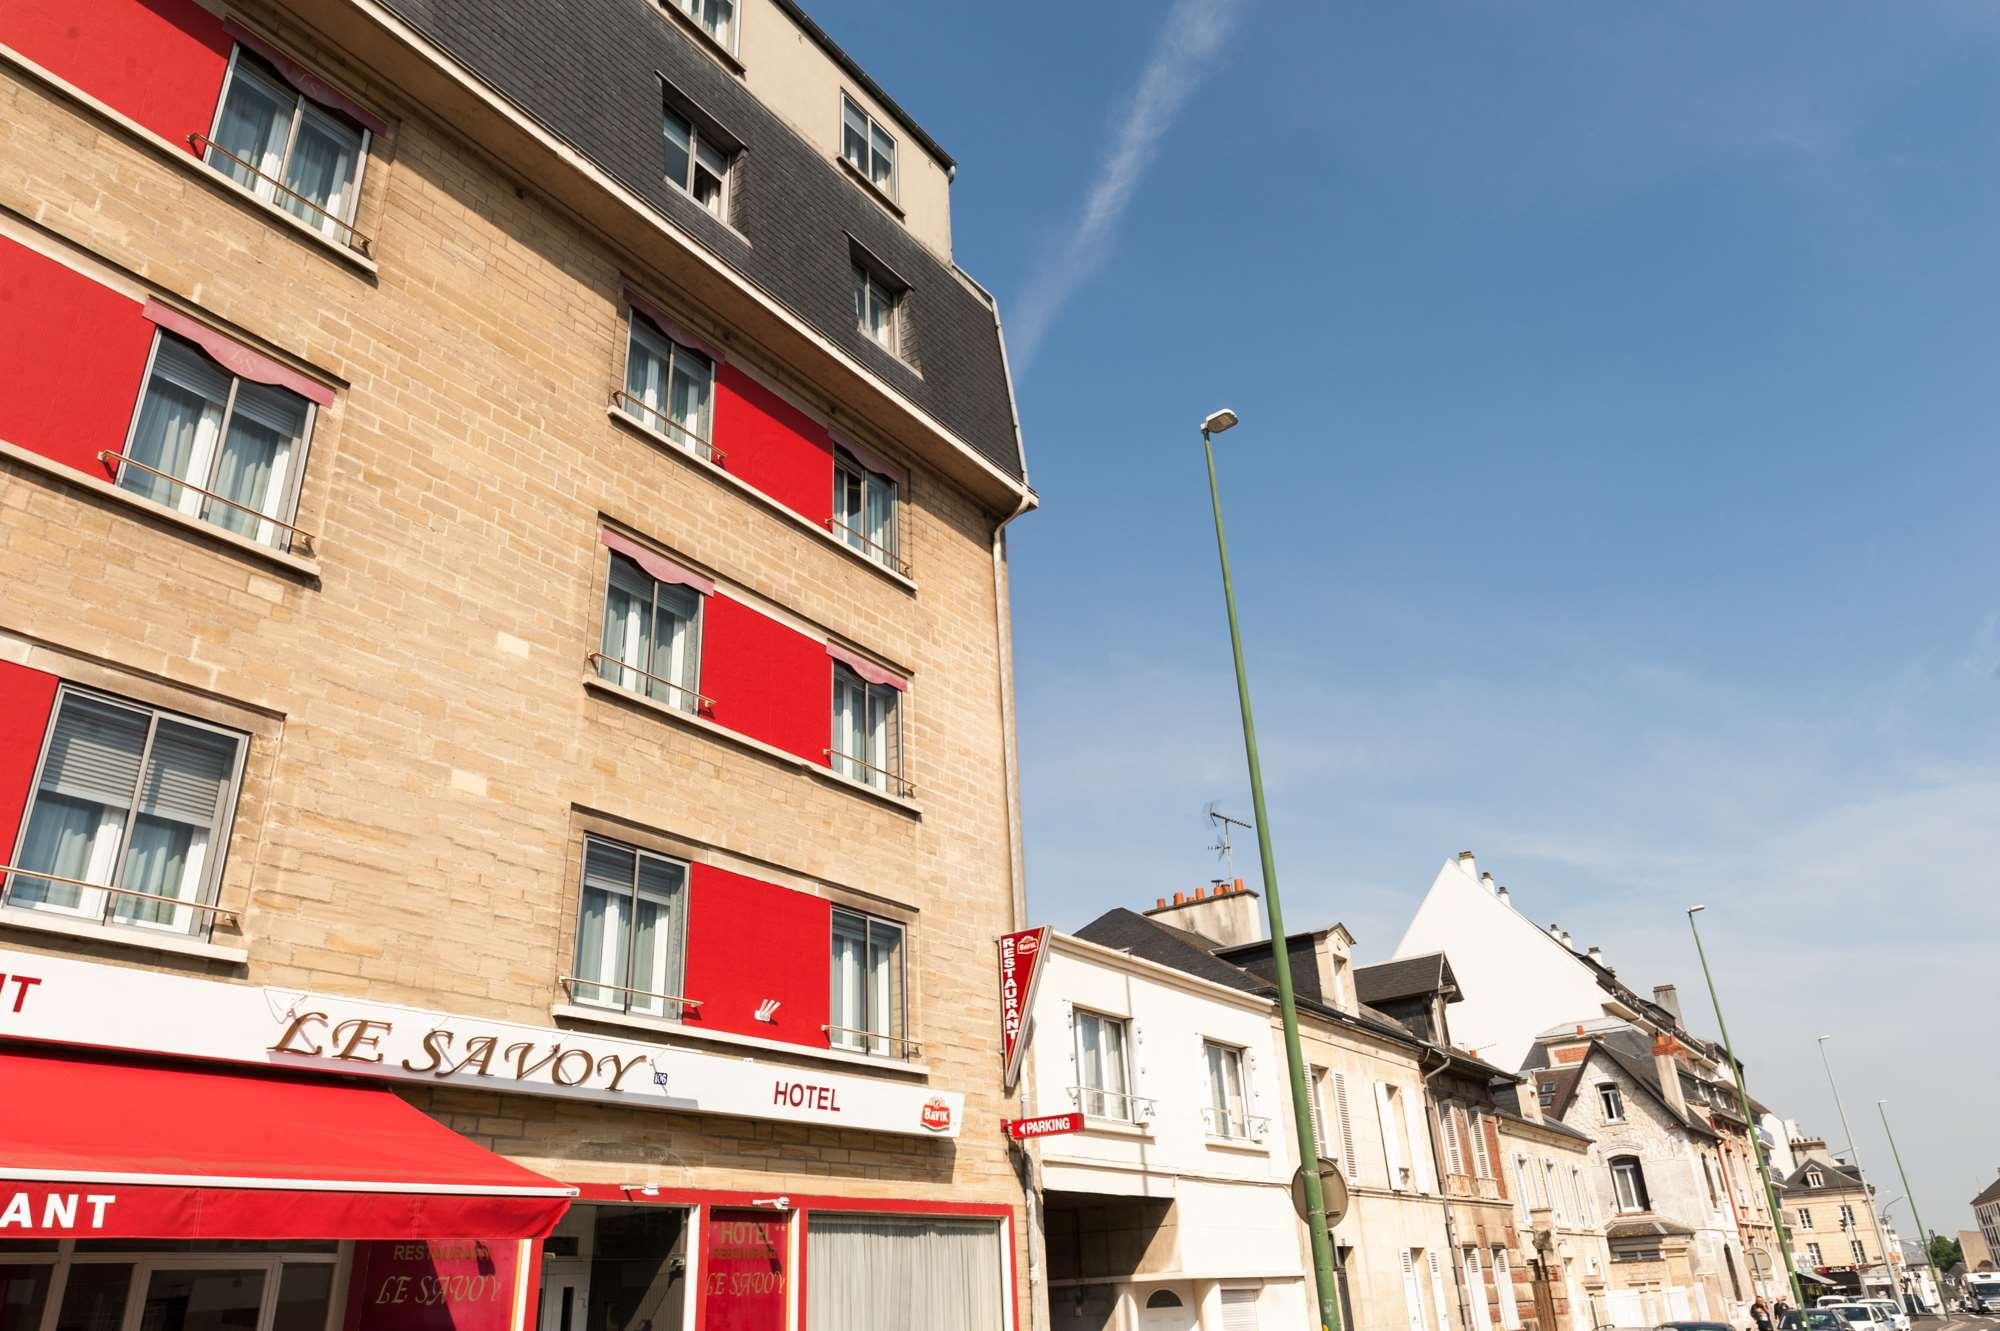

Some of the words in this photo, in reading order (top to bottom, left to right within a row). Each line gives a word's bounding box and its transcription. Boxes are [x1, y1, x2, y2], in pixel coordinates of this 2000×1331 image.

[0, 973, 42, 1013] T
[1002, 937, 1019, 1040] RESTAURANT
[266, 1011, 392, 1062] LE
[402, 1029, 648, 1092] SAVOY
[774, 1081, 840, 1112] HOTEL
[924, 1107, 949, 1122] BAVIK
[1026, 1116, 1070, 1134] PARKING
[0, 1192, 116, 1229] ANT
[720, 1222, 773, 1245] HOTEL
[376, 1275, 412, 1304] LE
